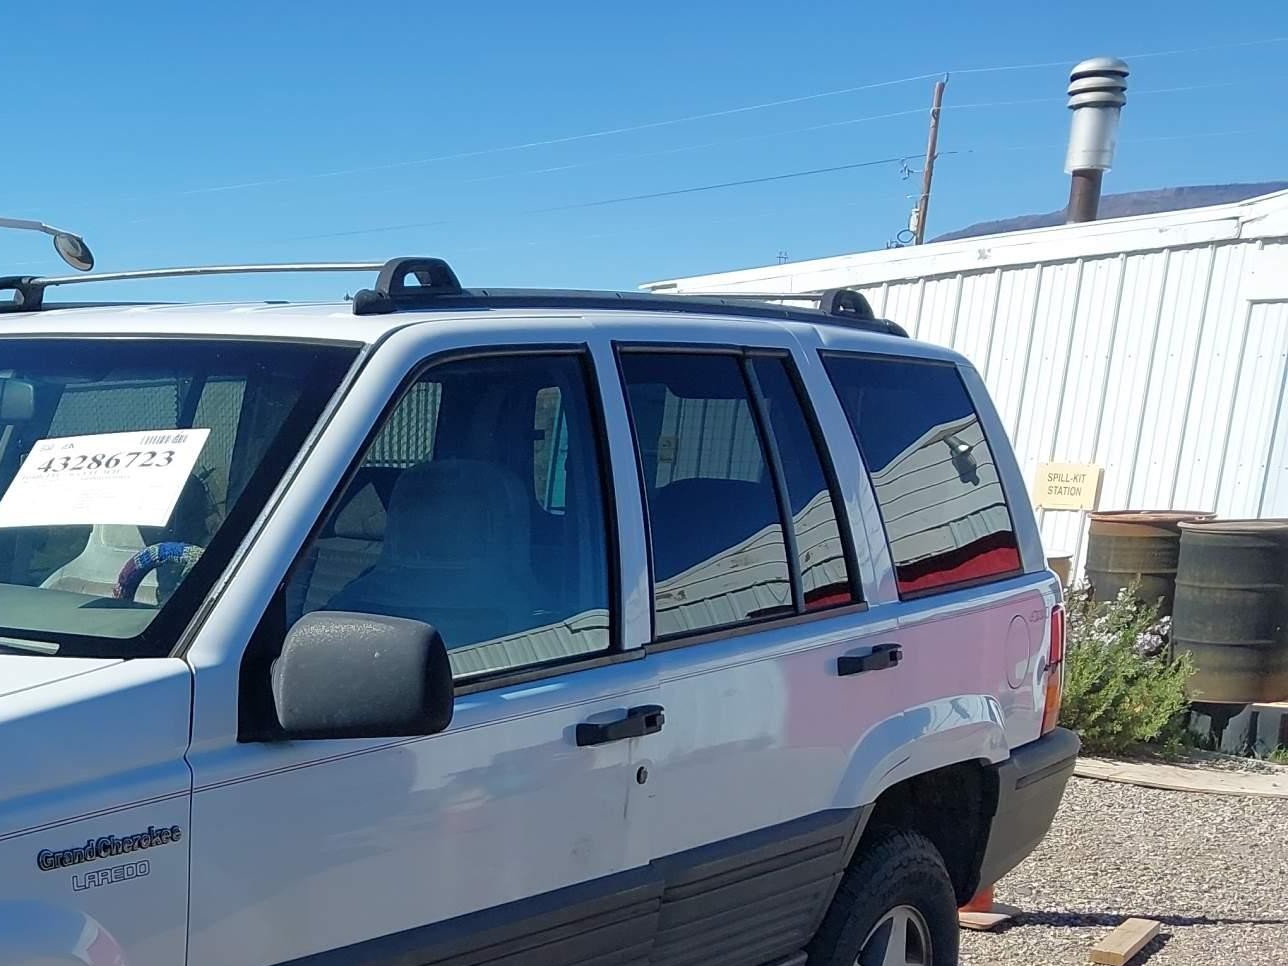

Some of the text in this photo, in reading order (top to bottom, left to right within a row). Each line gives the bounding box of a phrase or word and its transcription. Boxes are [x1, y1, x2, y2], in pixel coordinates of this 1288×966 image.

[36, 450, 177, 474] 43286723
[1047, 472, 1087, 483] SPILL-KIT
[1047, 485, 1082, 496] STATION
[38, 825, 182, 871] Grand Cherokee
[72, 860, 150, 891] LAREDO
